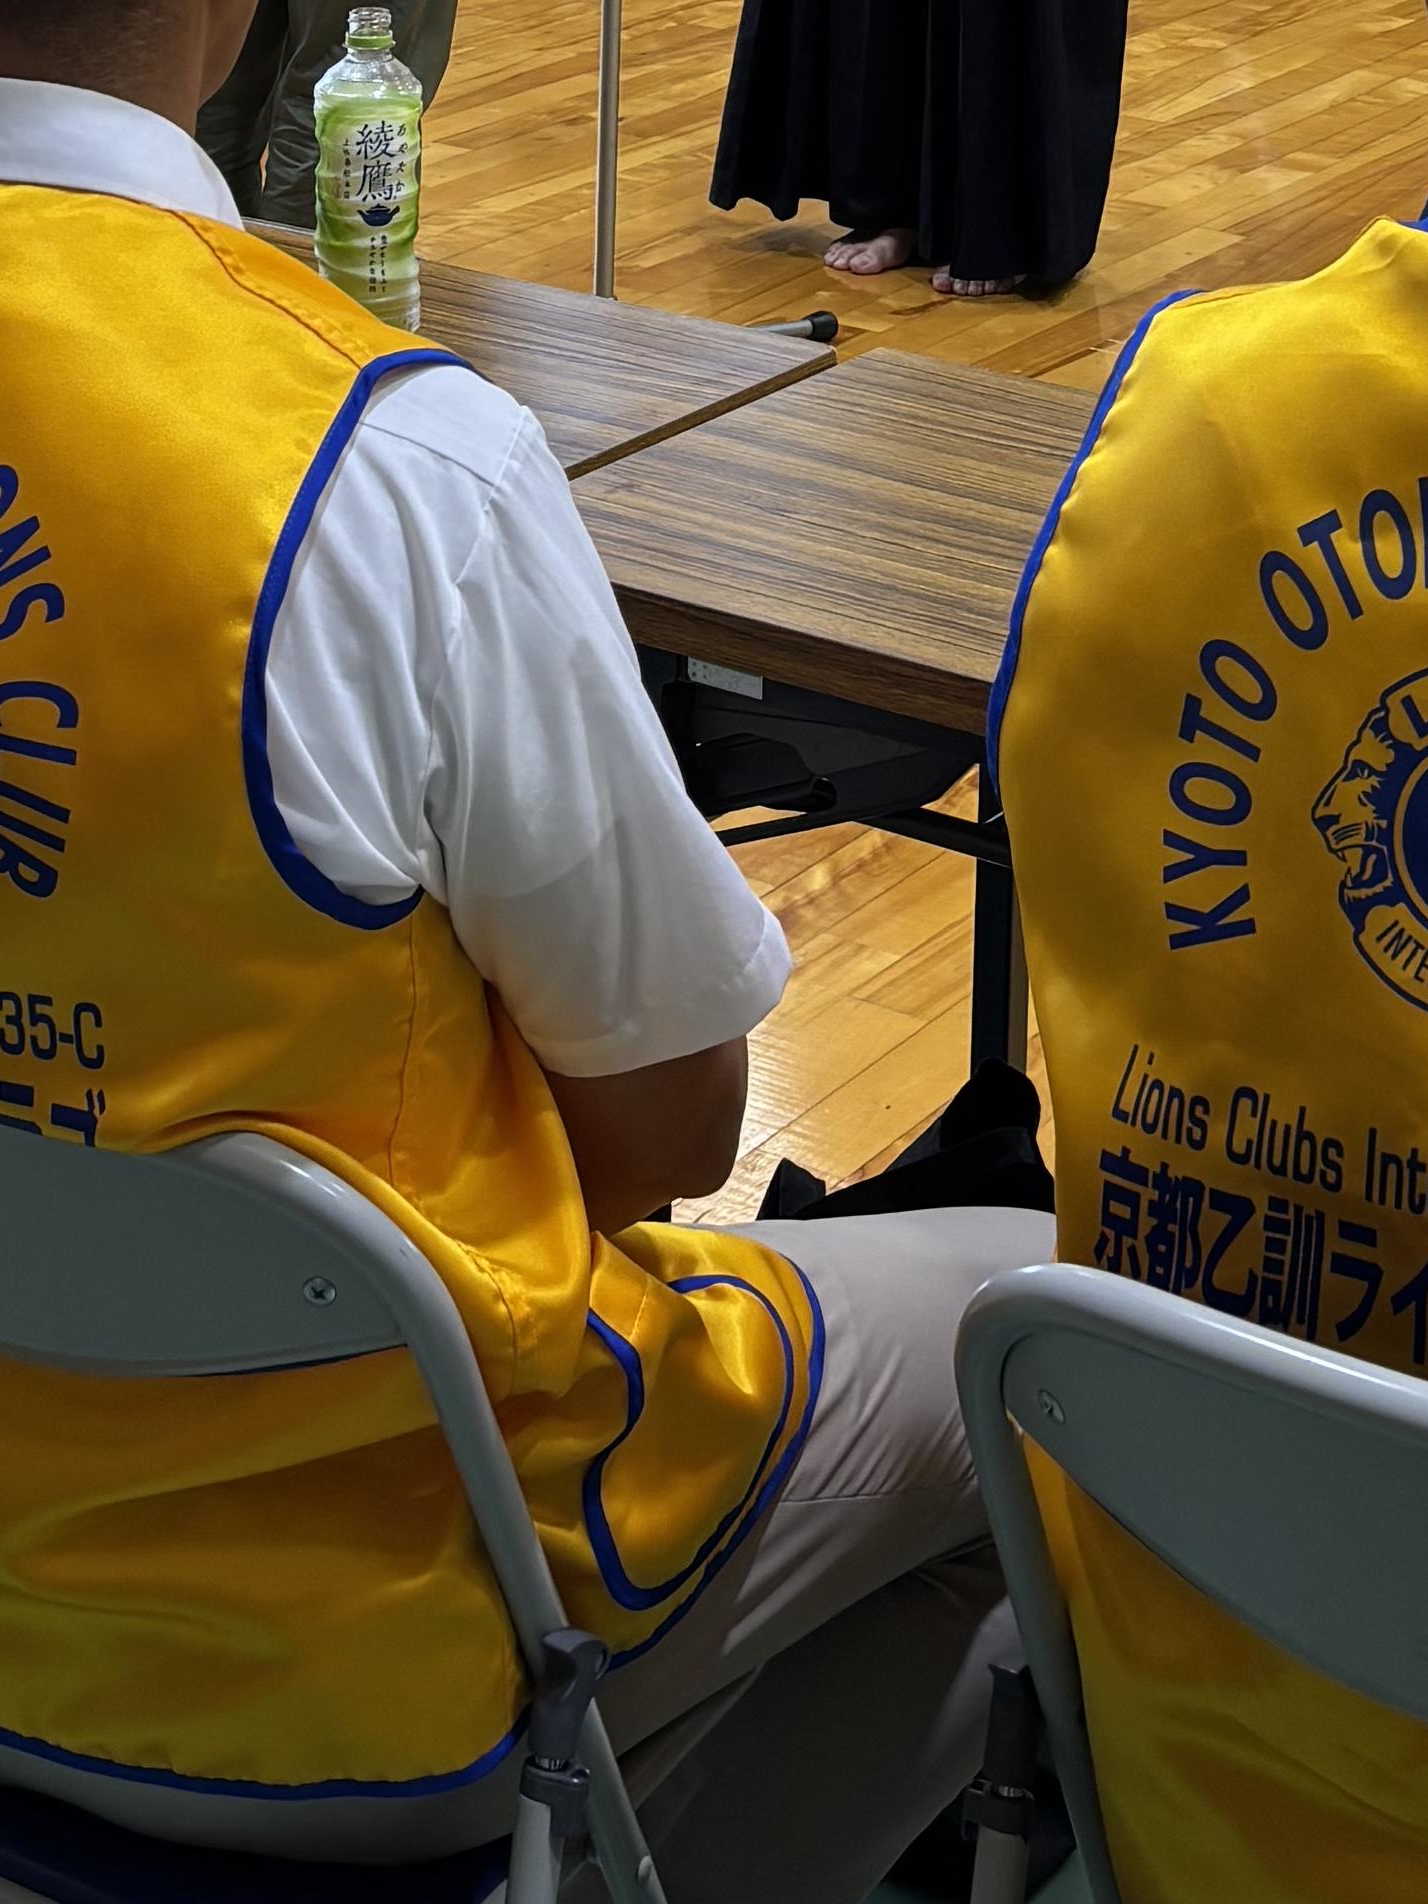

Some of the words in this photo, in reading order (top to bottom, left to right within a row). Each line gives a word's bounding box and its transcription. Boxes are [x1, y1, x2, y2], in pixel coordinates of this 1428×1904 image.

[355, 120, 398, 202] 綾鷹
[1162, 638, 1278, 952] KYOTO
[1110, 1042, 1210, 1152] Lions
[1224, 1085, 1346, 1195] Clubs
